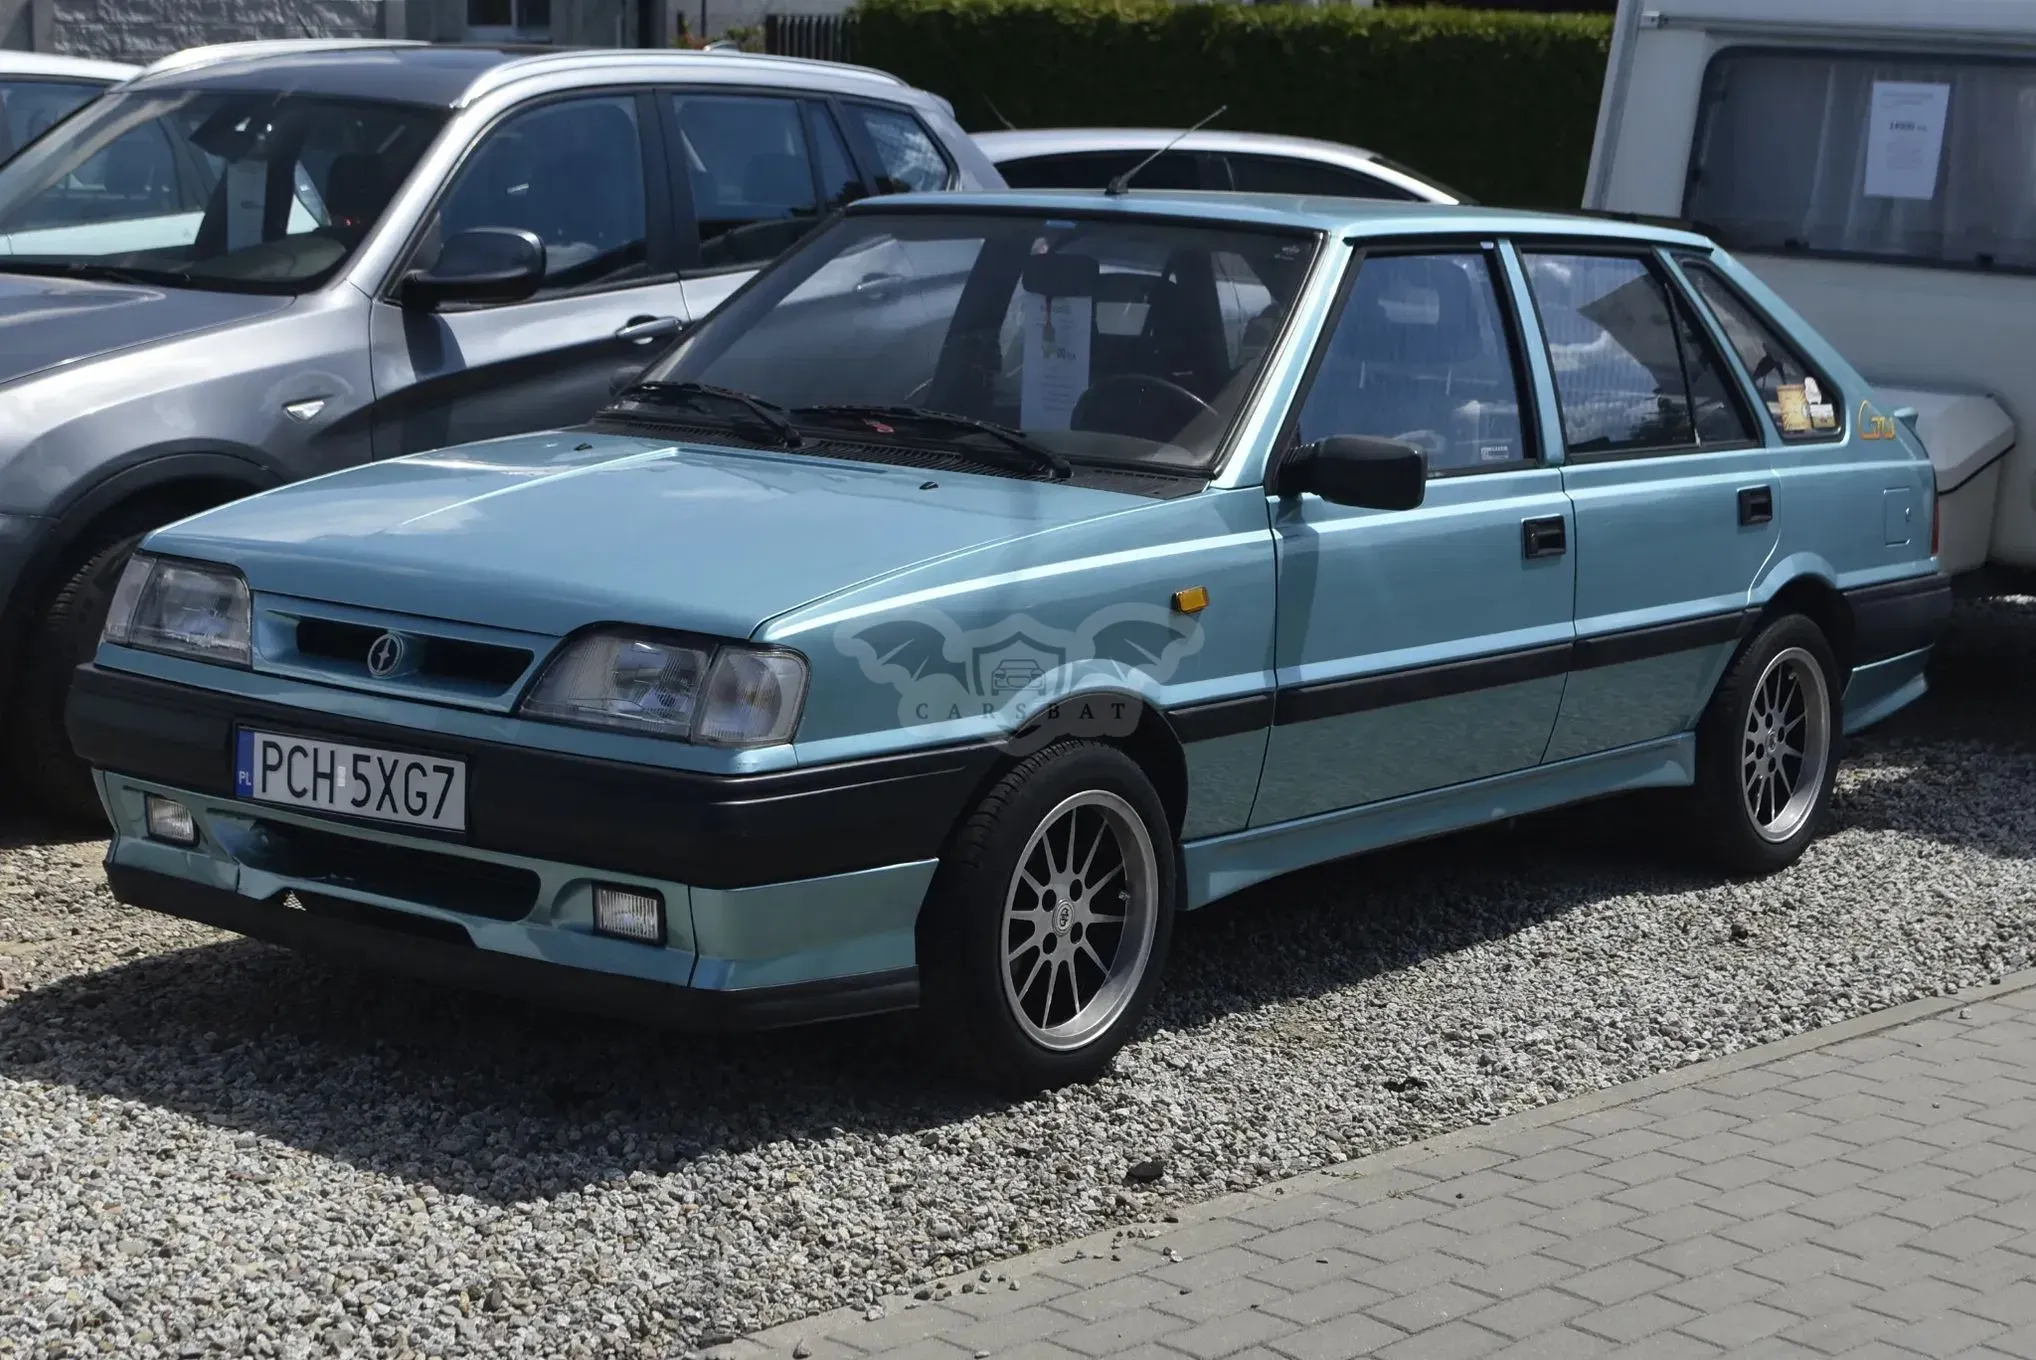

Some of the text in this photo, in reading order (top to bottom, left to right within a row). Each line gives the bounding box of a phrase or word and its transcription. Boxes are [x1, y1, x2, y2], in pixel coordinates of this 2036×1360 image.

[238, 770, 252, 787] PL
[261, 740, 455, 820] PCH 5XG7
